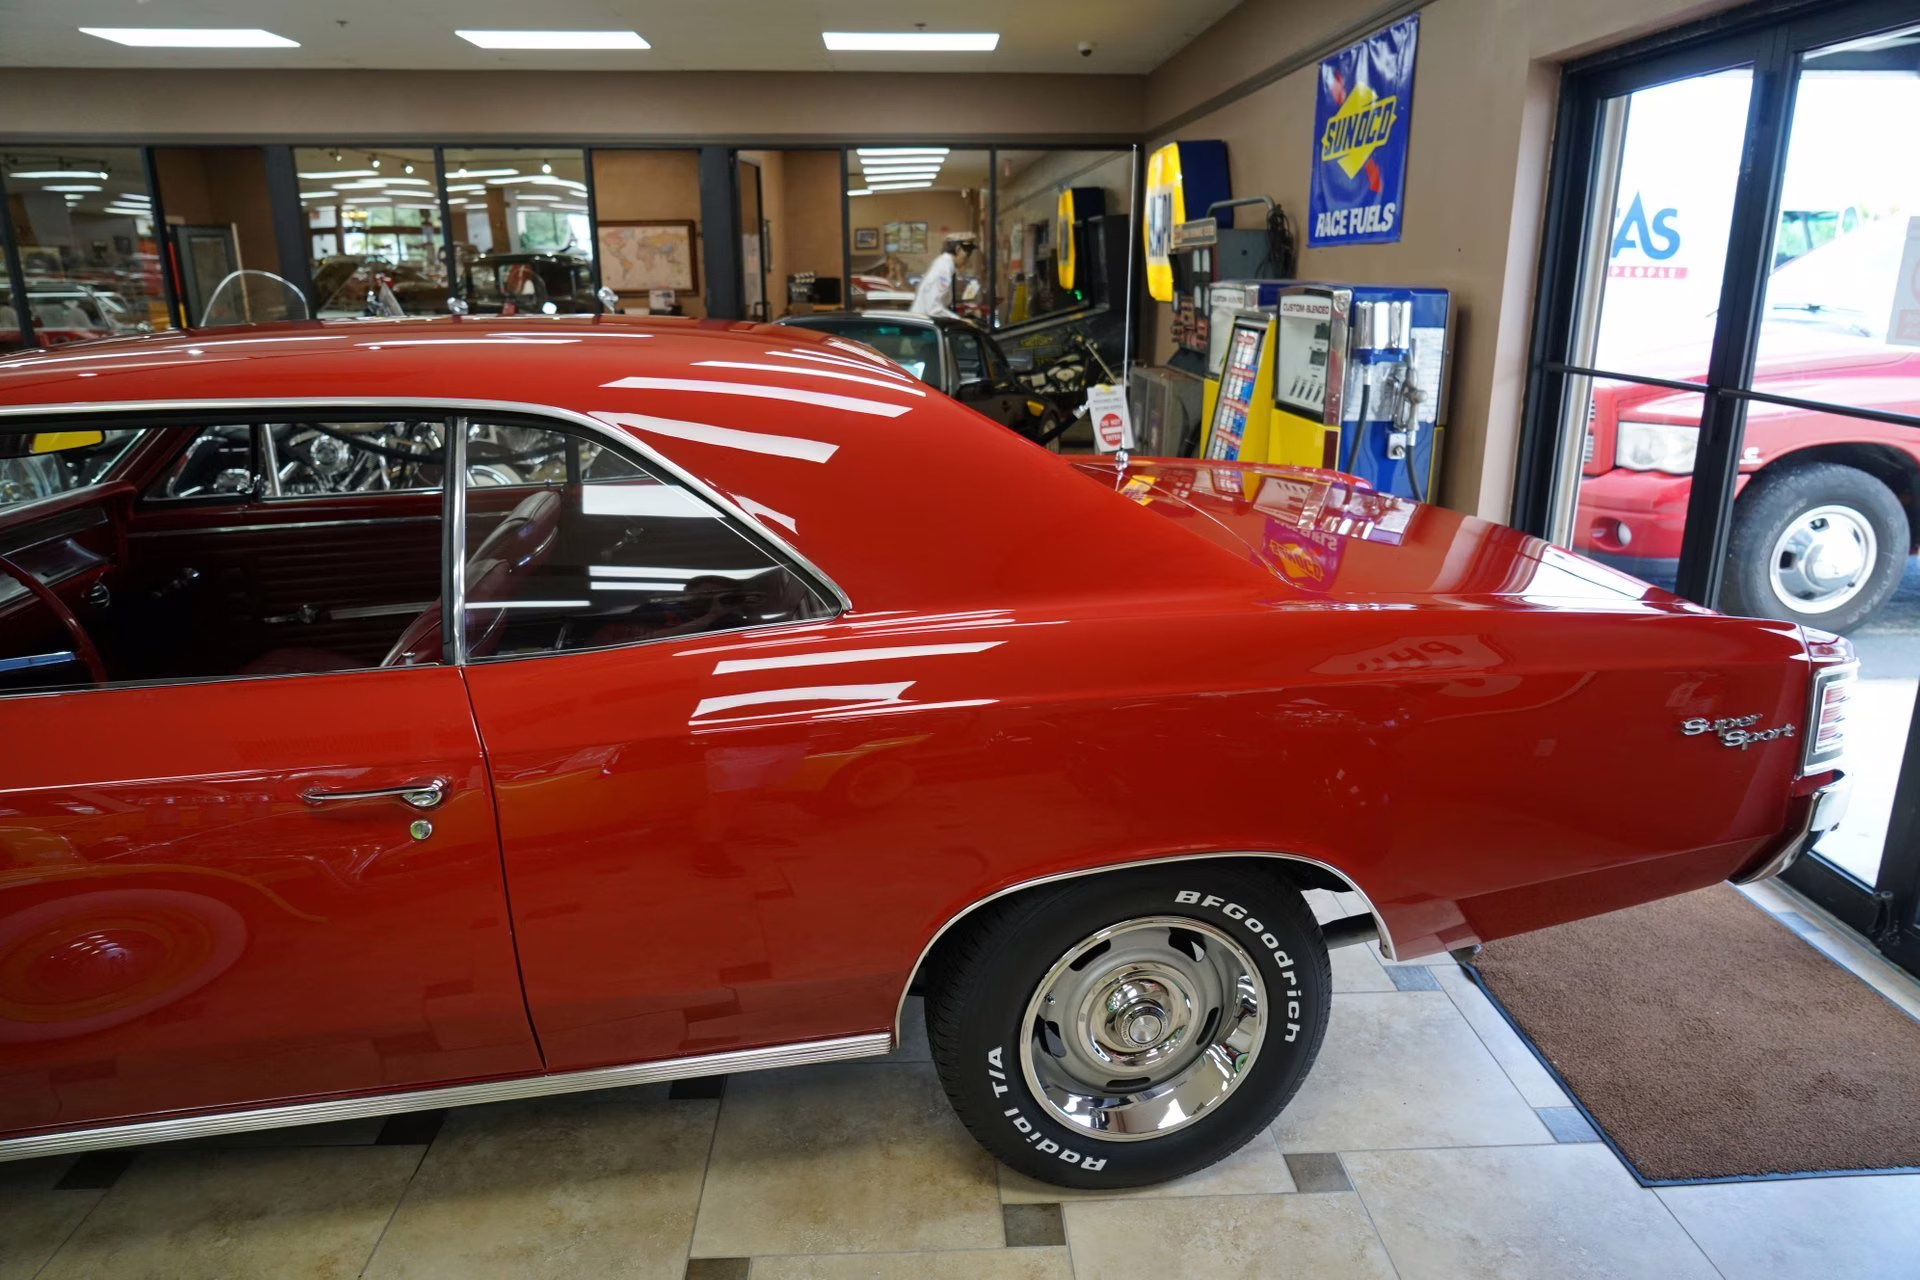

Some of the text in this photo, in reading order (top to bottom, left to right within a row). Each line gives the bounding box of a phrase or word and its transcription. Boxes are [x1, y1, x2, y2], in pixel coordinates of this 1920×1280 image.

[1324, 101, 1394, 156] SUNOCO
[1315, 203, 1396, 238] RACE FUELS
[1680, 713, 1764, 737] Super
[1722, 723, 1797, 751] Sport
[1174, 890, 1302, 1043] BFGoodrich
[987, 1046, 1009, 1099] T/A
